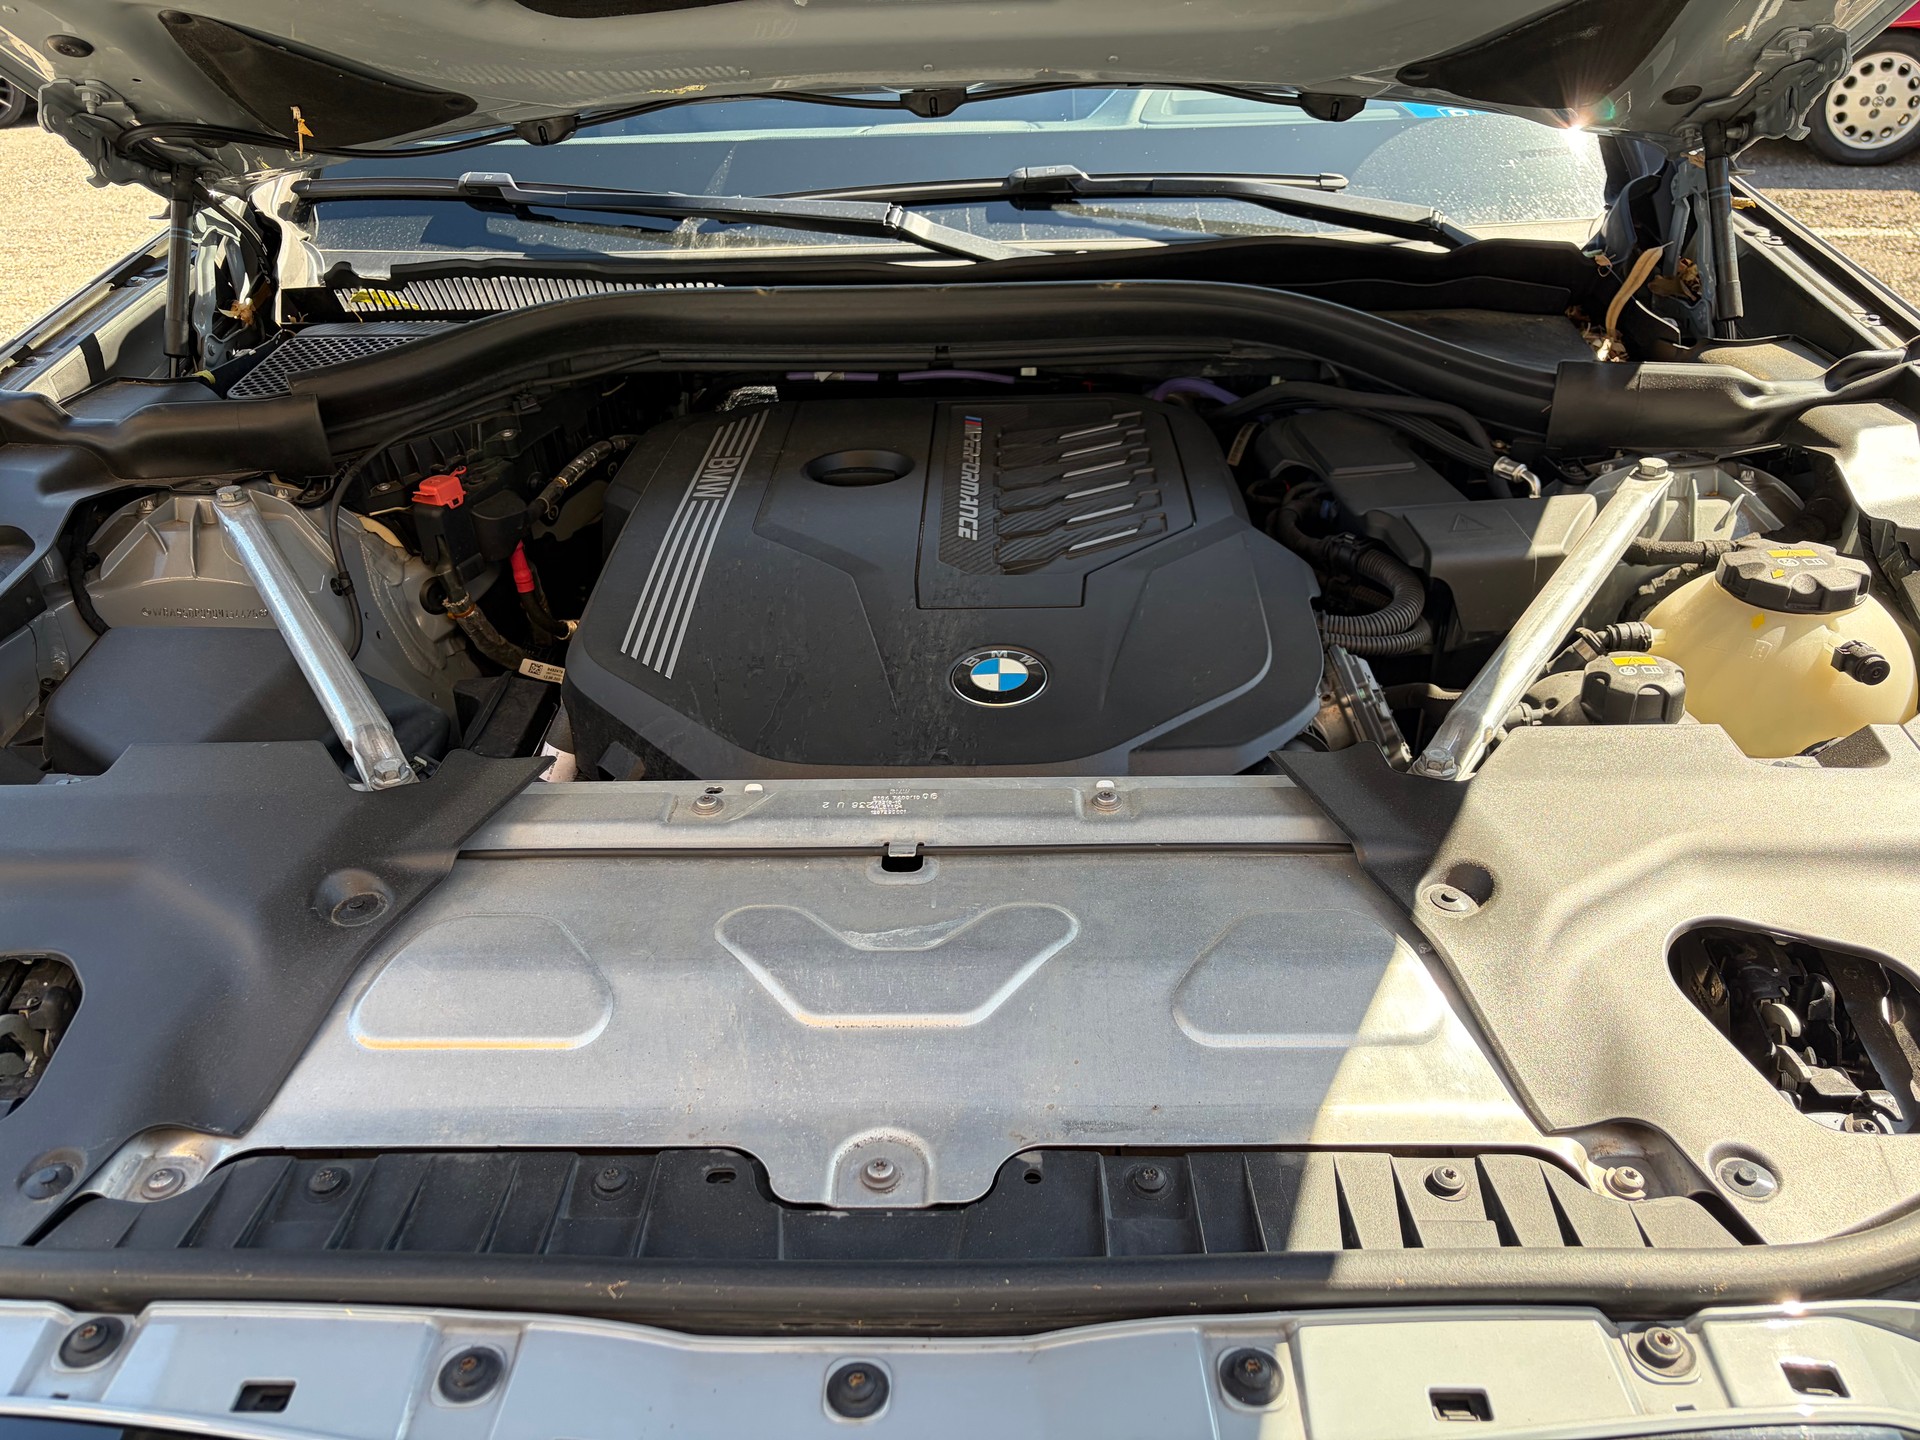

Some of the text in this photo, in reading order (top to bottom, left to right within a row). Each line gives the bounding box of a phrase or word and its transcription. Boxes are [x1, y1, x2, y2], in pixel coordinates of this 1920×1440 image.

[691, 455, 741, 498] BMW
[957, 432, 982, 541] PERFORMANCE
[962, 650, 1039, 667] BMW
